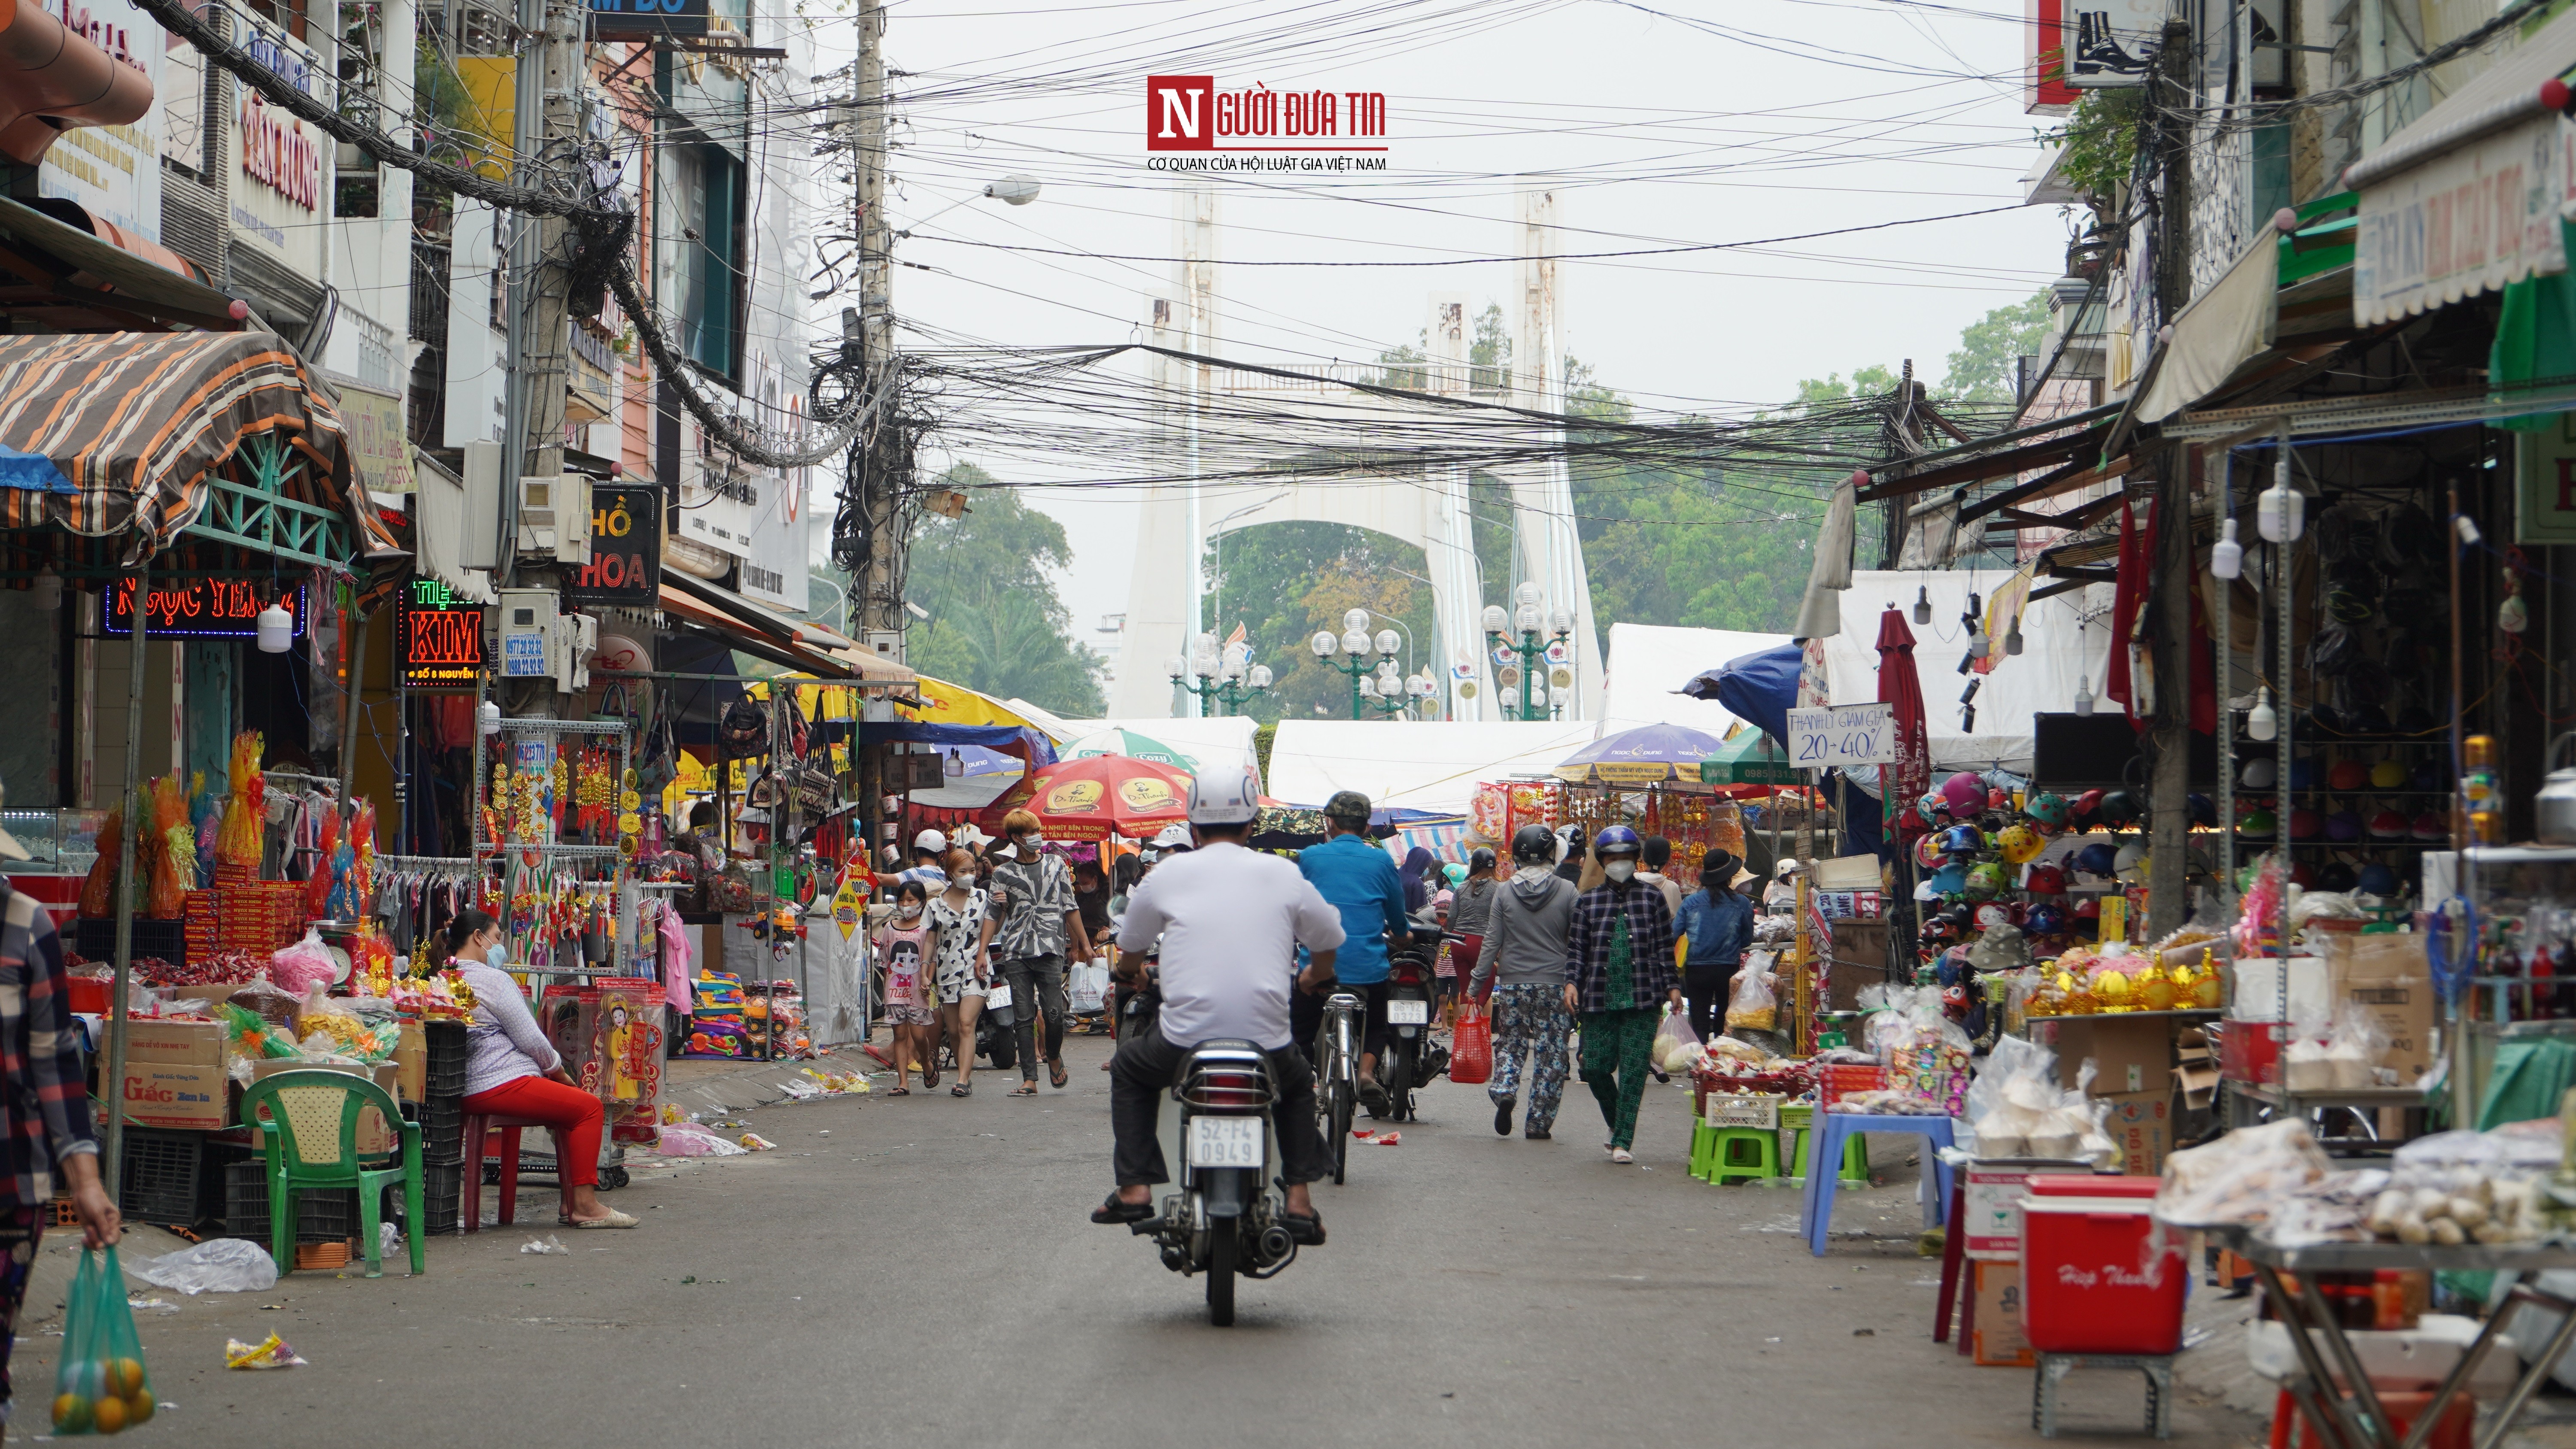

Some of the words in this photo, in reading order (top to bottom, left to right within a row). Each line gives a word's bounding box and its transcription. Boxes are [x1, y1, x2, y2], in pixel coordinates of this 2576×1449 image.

[409, 611, 480, 663] KIM
[418, 667, 430, 679] SỐ
[439, 667, 474, 679] NGUYỄN
[1799, 734, 1828, 761] 20
[967, 759, 988, 768] DUNG
[1139, 753, 1168, 764] Cozy
[123, 1076, 173, 1103] Gấc
[1202, 1119, 1251, 1140] 52-F4
[1202, 1142, 1252, 1162] 0949
